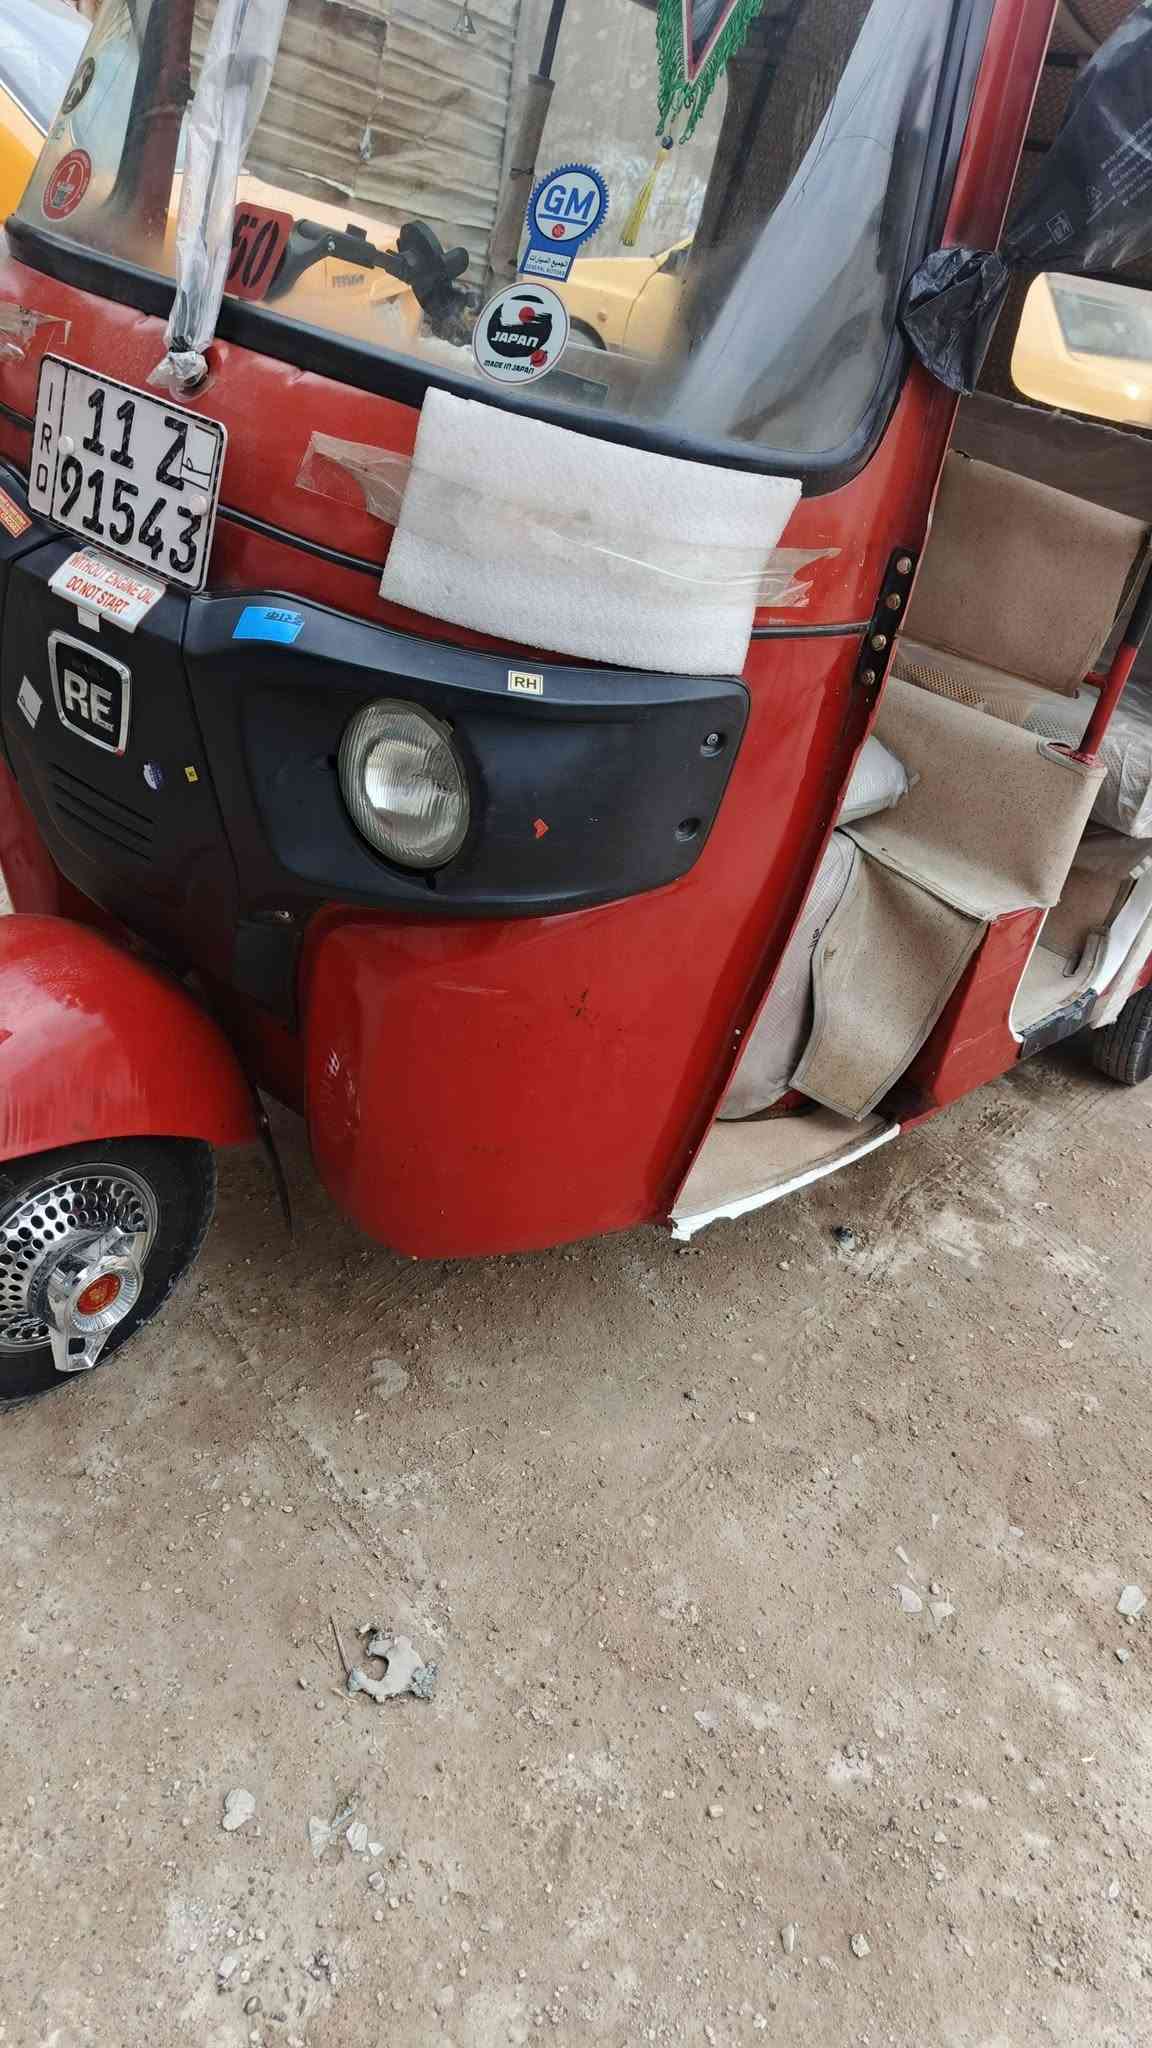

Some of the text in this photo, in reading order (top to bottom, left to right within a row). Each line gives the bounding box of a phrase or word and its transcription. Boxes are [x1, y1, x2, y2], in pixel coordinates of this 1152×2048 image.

[543, 184, 596, 221] GM
[490, 331, 539, 348] JAPAN
[36, 382, 53, 494] IRQ
[83, 388, 188, 491] 11 Z
[60, 455, 201, 573] 91543
[66, 576, 130, 614] DO NOT START
[69, 555, 156, 604] WITHOUT ENGINE OIL
[63, 668, 114, 732] RE
[514, 676, 537, 690] RH
